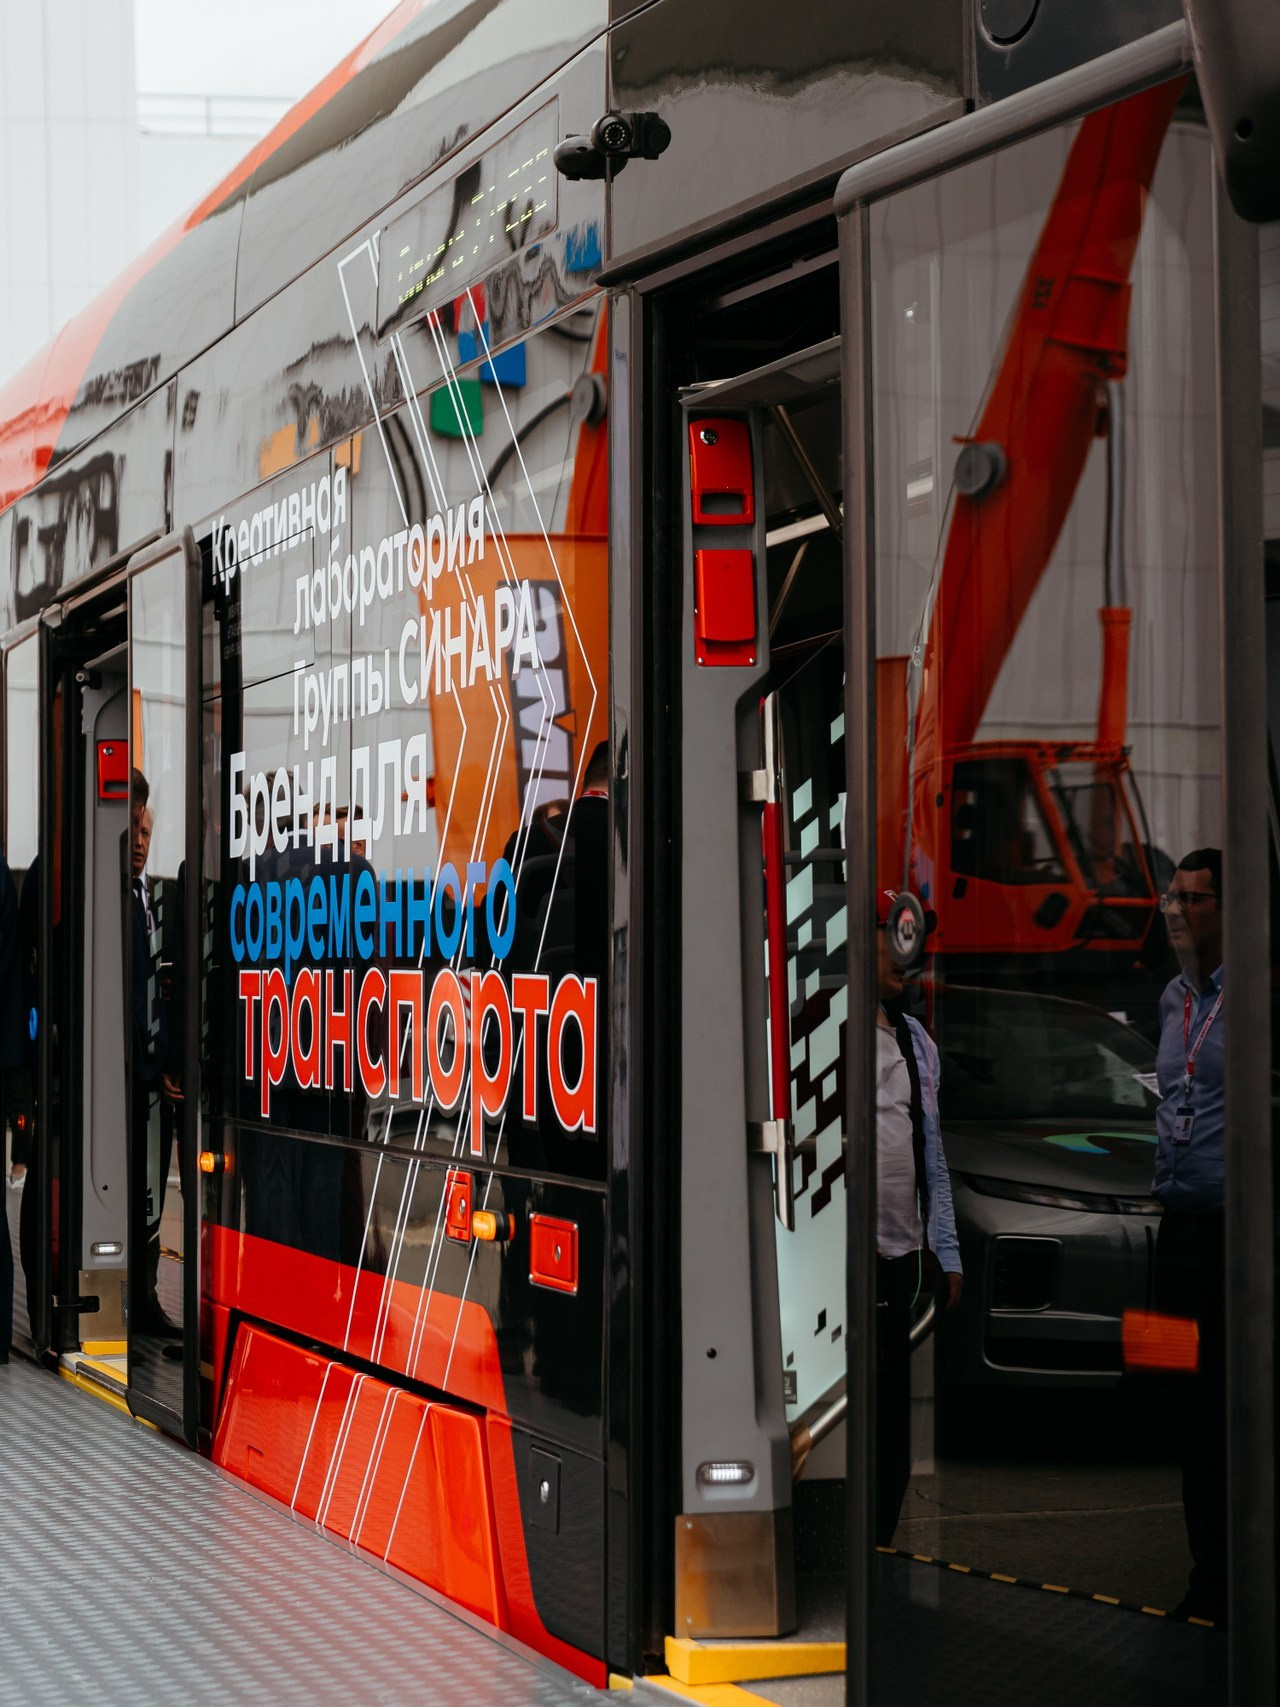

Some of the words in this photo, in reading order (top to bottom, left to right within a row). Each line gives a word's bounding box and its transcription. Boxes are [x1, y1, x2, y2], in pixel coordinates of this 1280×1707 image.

[211, 465, 347, 596] Креативная
[293, 494, 485, 635] лаборатория
[293, 647, 391, 751] Группы
[398, 578, 540, 705] СИНАРА
[229, 750, 339, 882] Бренд
[344, 732, 427, 863] для
[229, 857, 517, 985] современного
[238, 966, 598, 1157] транспорта
